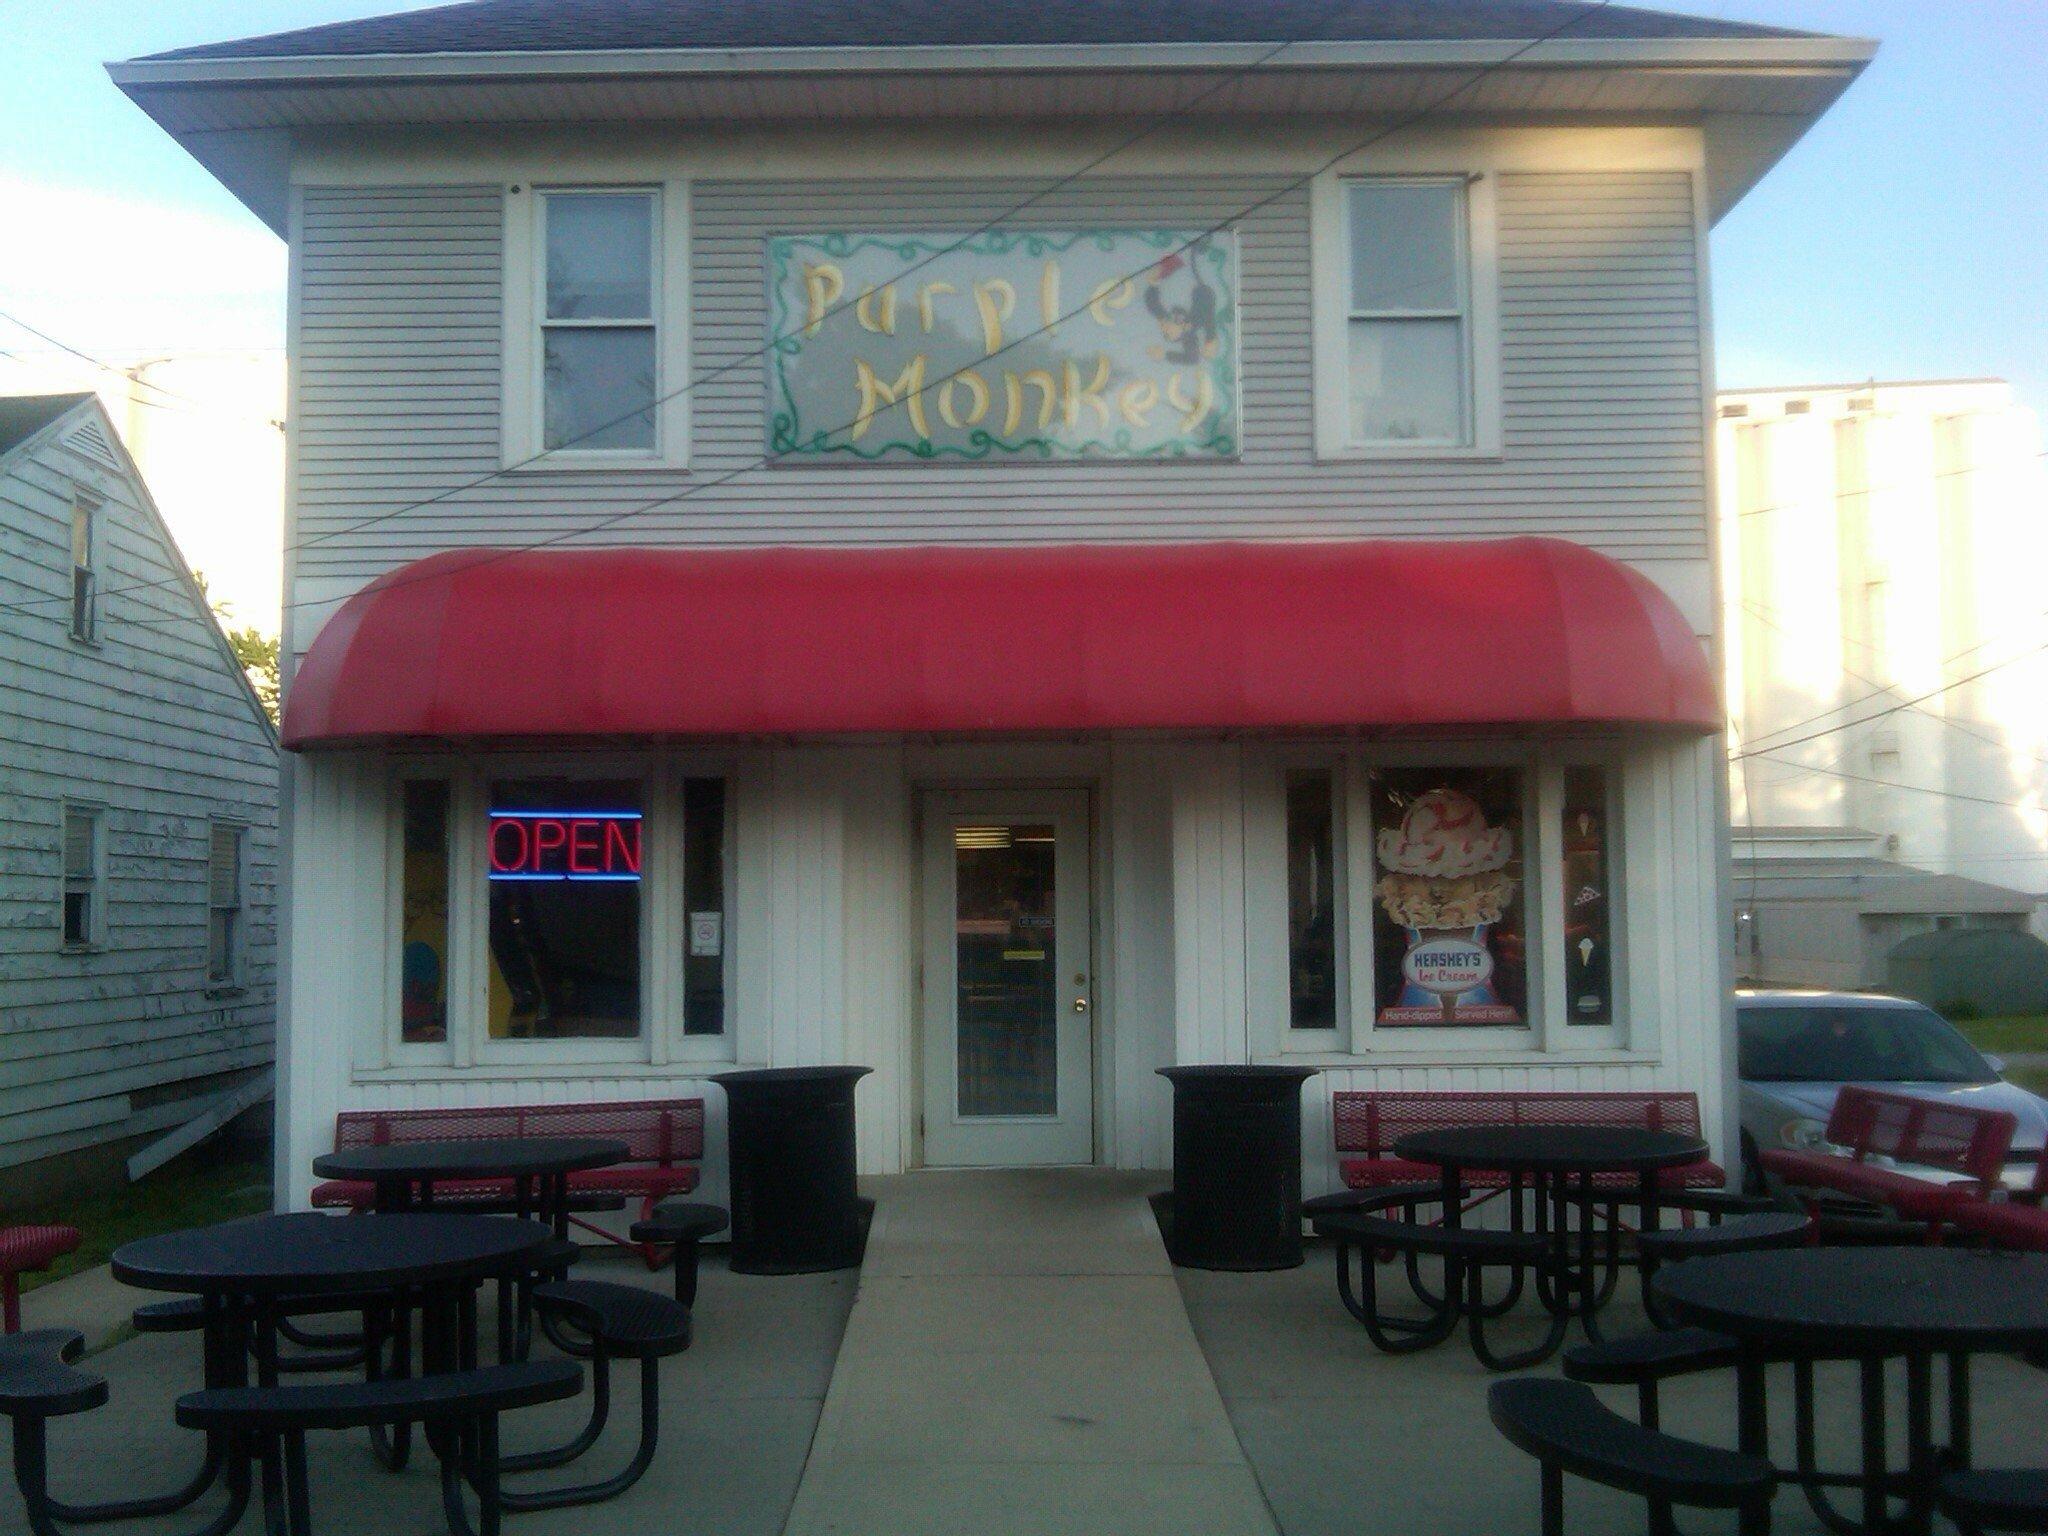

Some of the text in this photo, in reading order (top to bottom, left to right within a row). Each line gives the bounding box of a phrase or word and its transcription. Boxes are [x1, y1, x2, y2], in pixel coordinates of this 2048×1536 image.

[806, 260, 1134, 355] Purple
[488, 818, 642, 873] OPEN
[1414, 952, 1481, 967] HERSHEY'S
[1417, 969, 1478, 982] Ice Cream
